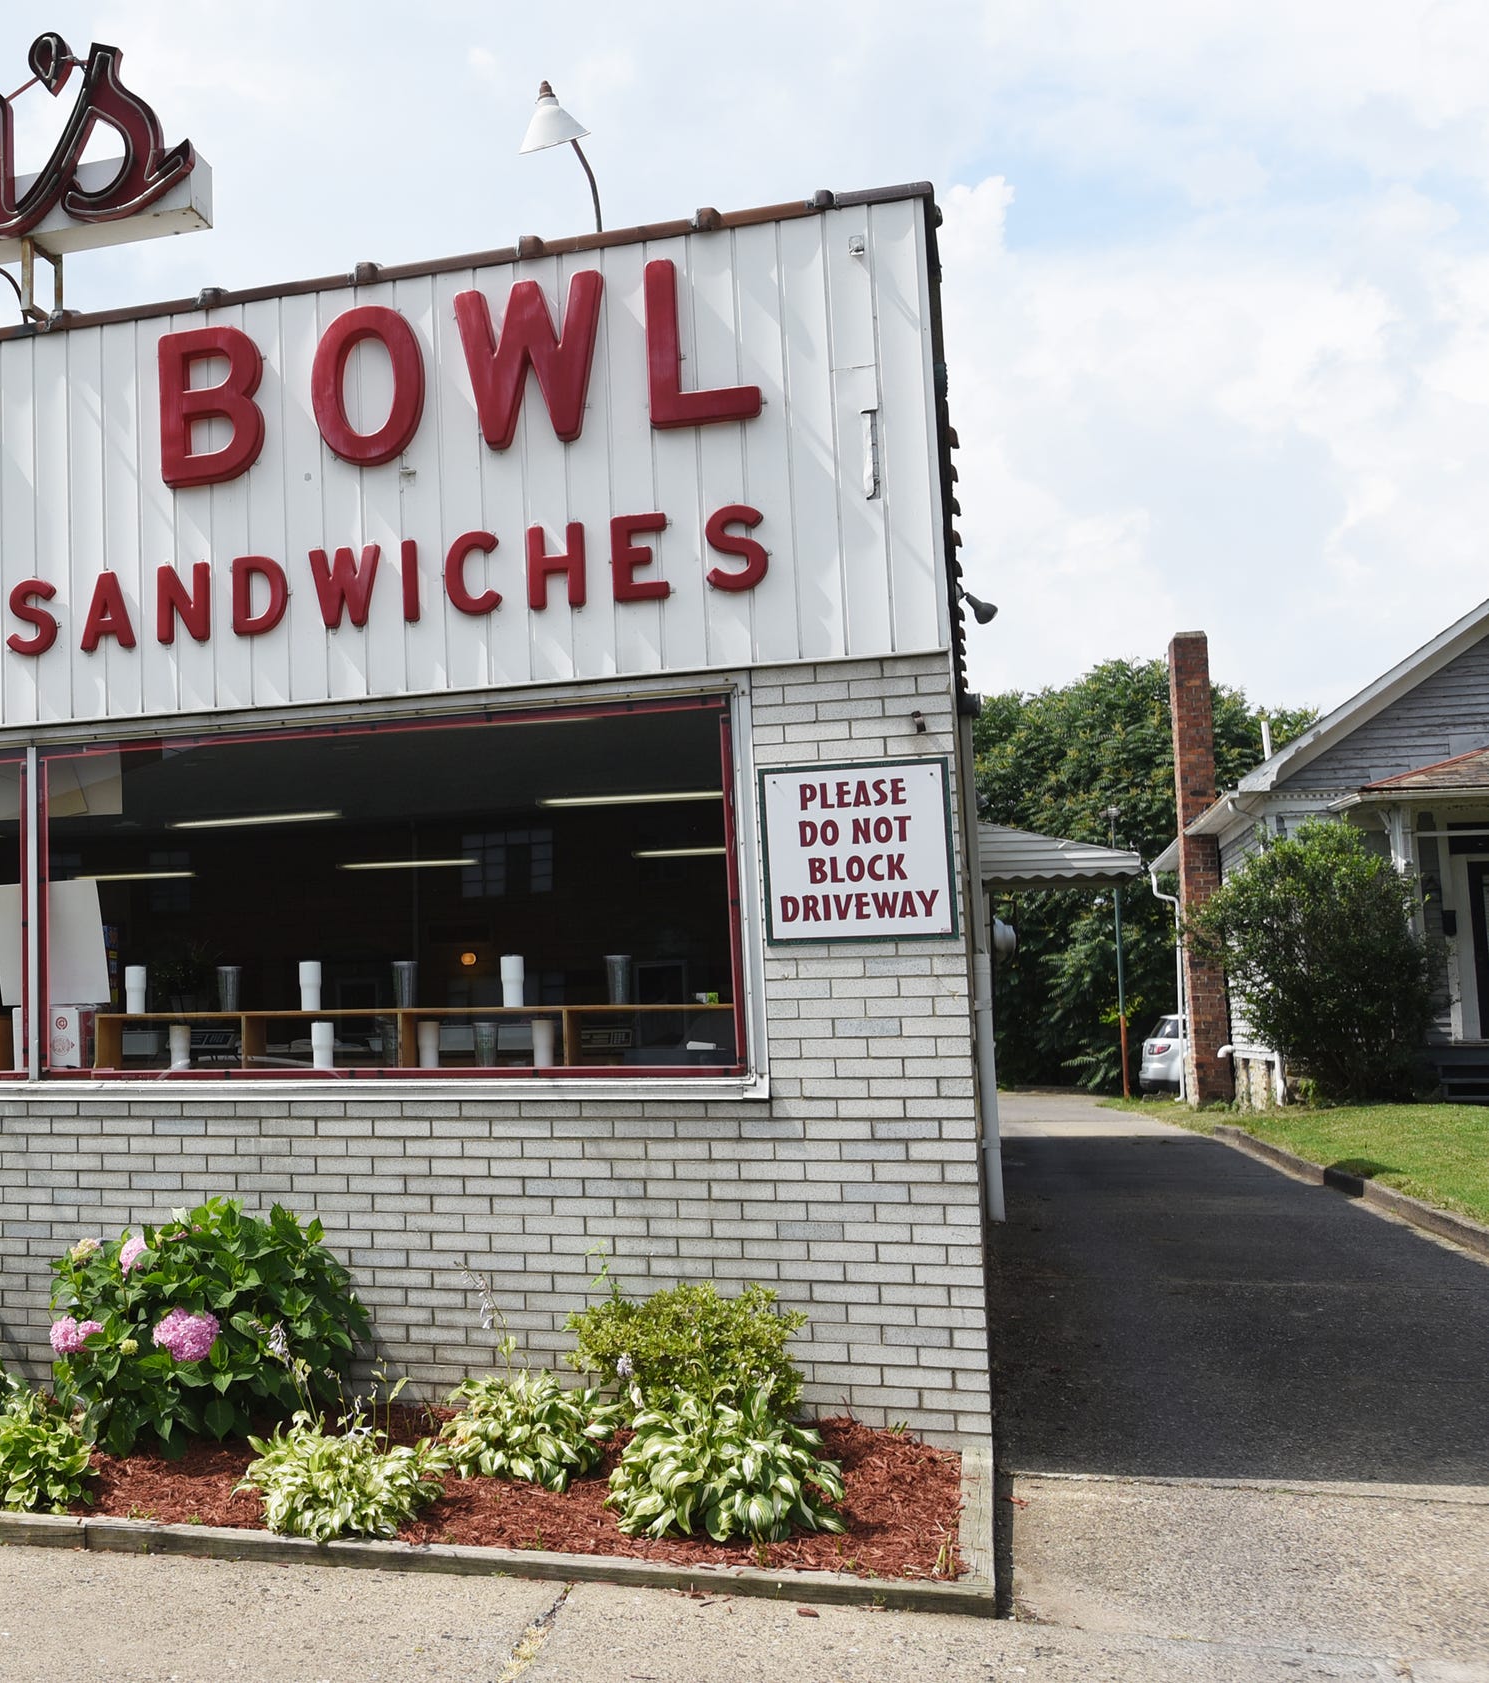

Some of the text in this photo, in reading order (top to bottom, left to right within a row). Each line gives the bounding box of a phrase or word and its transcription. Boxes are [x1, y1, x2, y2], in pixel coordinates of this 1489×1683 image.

[157, 257, 763, 488] BOWL
[5, 503, 770, 657] SANDWICHES
[799, 778, 908, 811] PLEASE
[798, 815, 912, 848] DO NOT
[808, 853, 908, 884] BLOCK
[780, 889, 940, 923] DRIVEWAY
